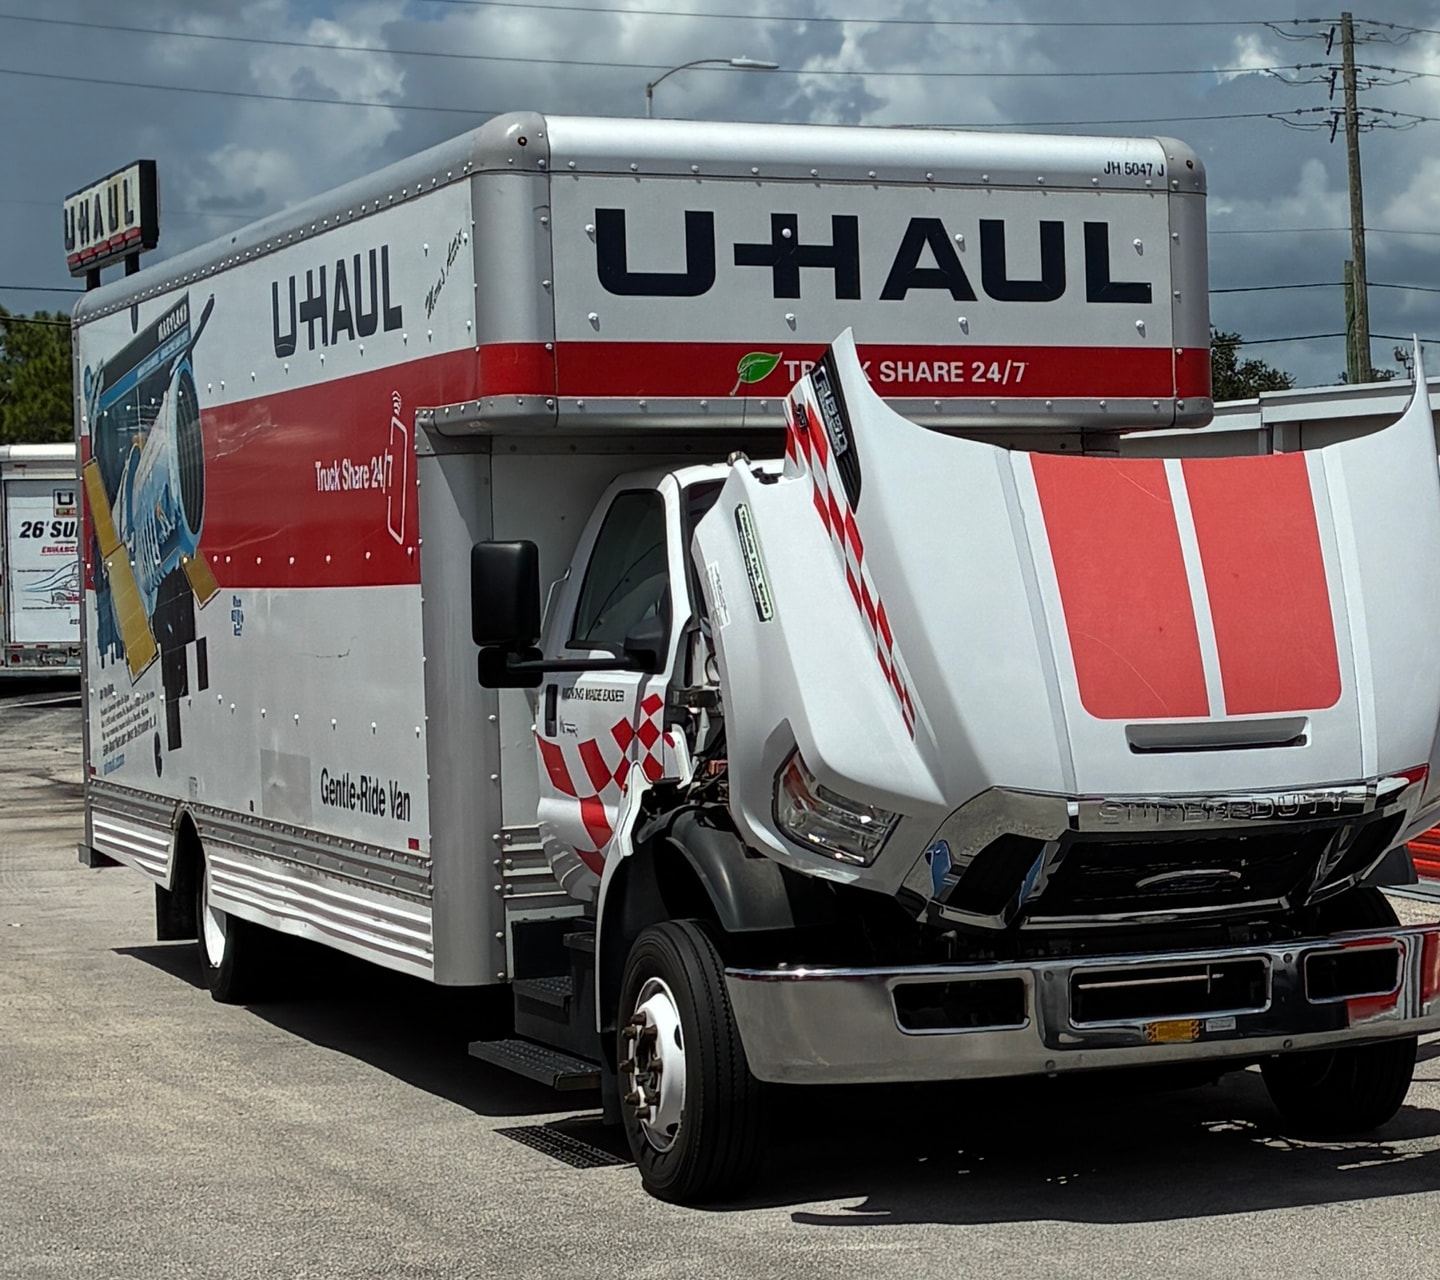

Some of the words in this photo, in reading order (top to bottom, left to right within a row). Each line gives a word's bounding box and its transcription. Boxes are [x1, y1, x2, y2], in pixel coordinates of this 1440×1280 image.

[1103, 160, 1121, 176] JH
[1124, 161, 1153, 177] 5047
[1157, 163, 1165, 177] J
[879, 360, 964, 383] SHARE
[970, 359, 1027, 386] 24/7
[315, 460, 341, 492] Truck
[342, 458, 370, 491] Share
[371, 447, 394, 495] 24/7
[50, 521, 78, 539] SU
[320, 767, 387, 817] Gentle-Ride
[388, 779, 411, 822] Van
